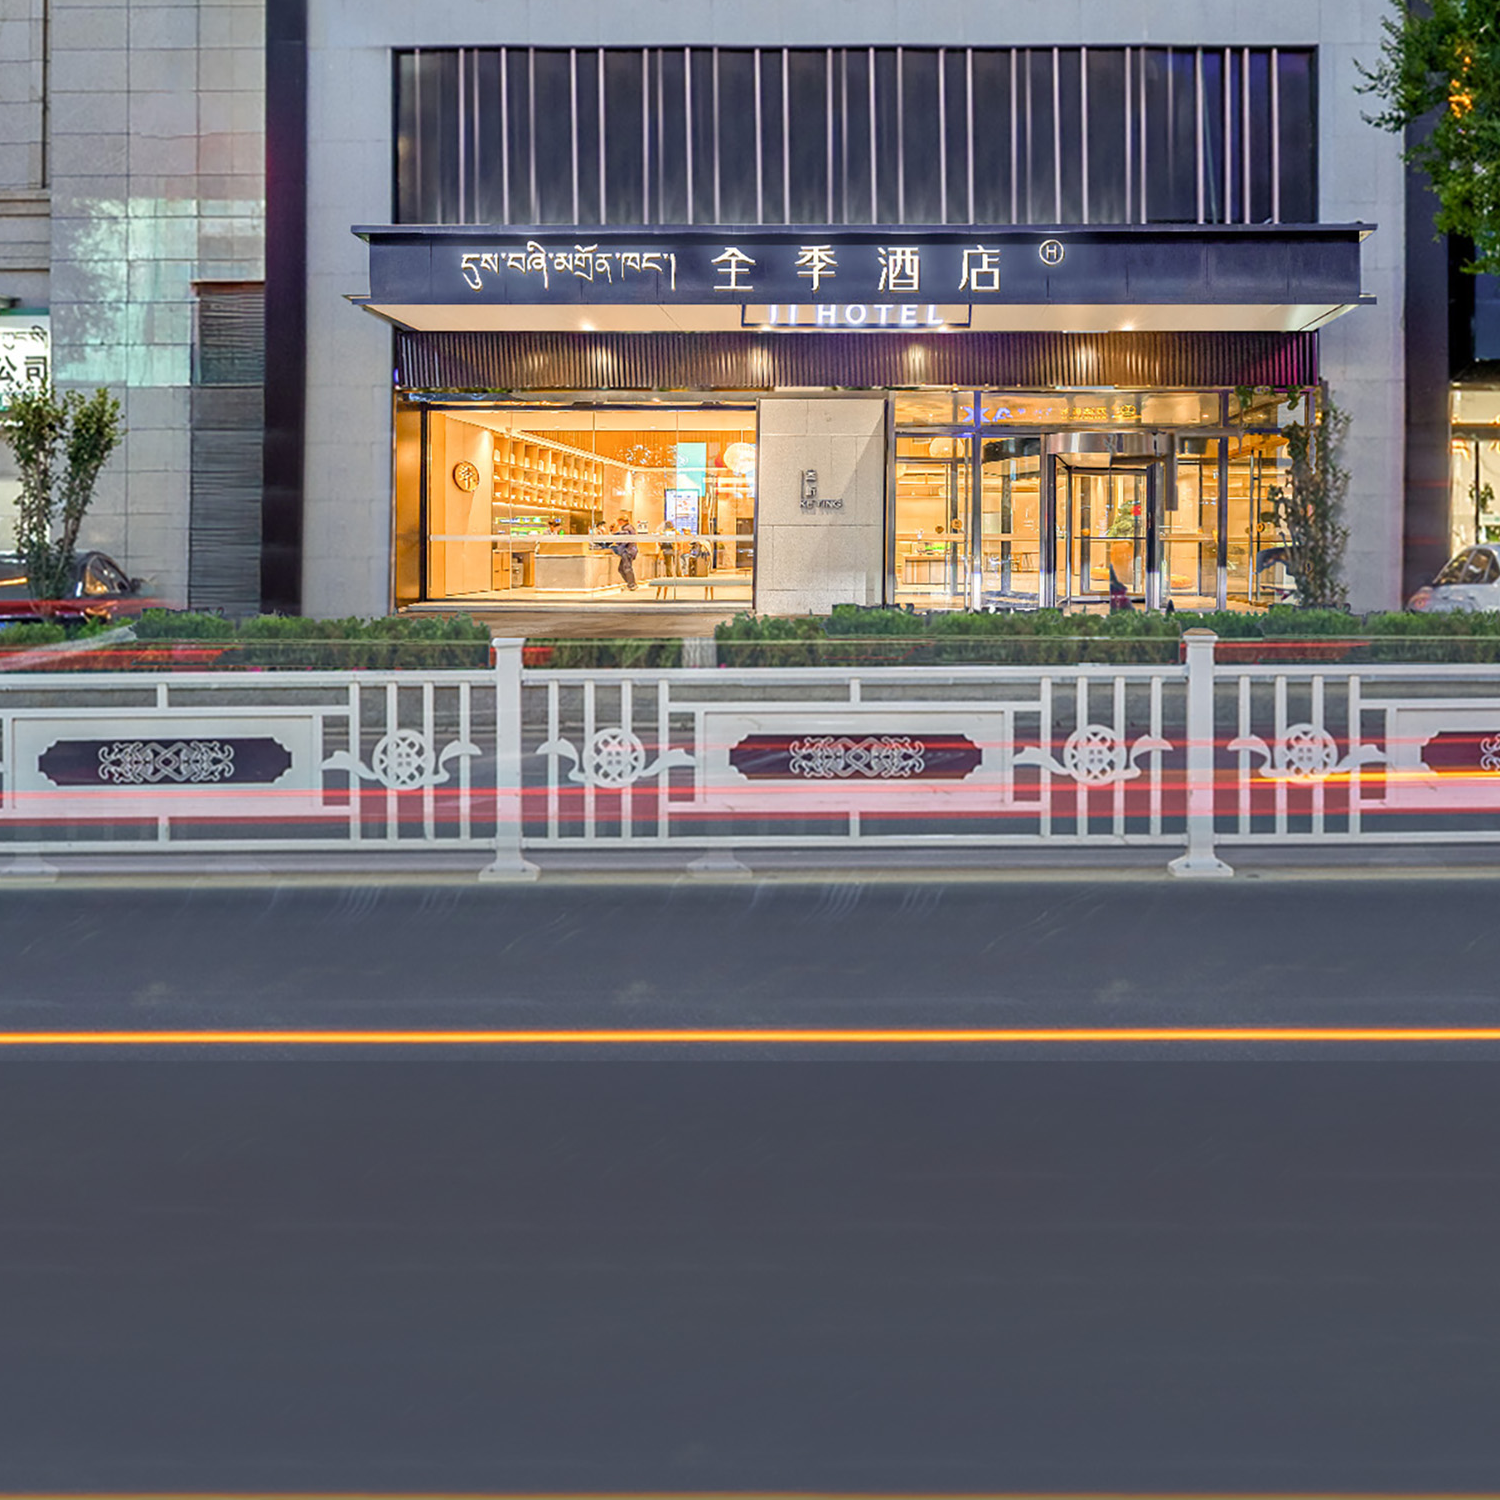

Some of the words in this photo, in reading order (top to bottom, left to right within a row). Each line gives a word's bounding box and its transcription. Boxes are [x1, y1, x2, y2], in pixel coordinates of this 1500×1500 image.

[711, 244, 1001, 293] 全季酒店
[817, 304, 944, 327] HOTEL
